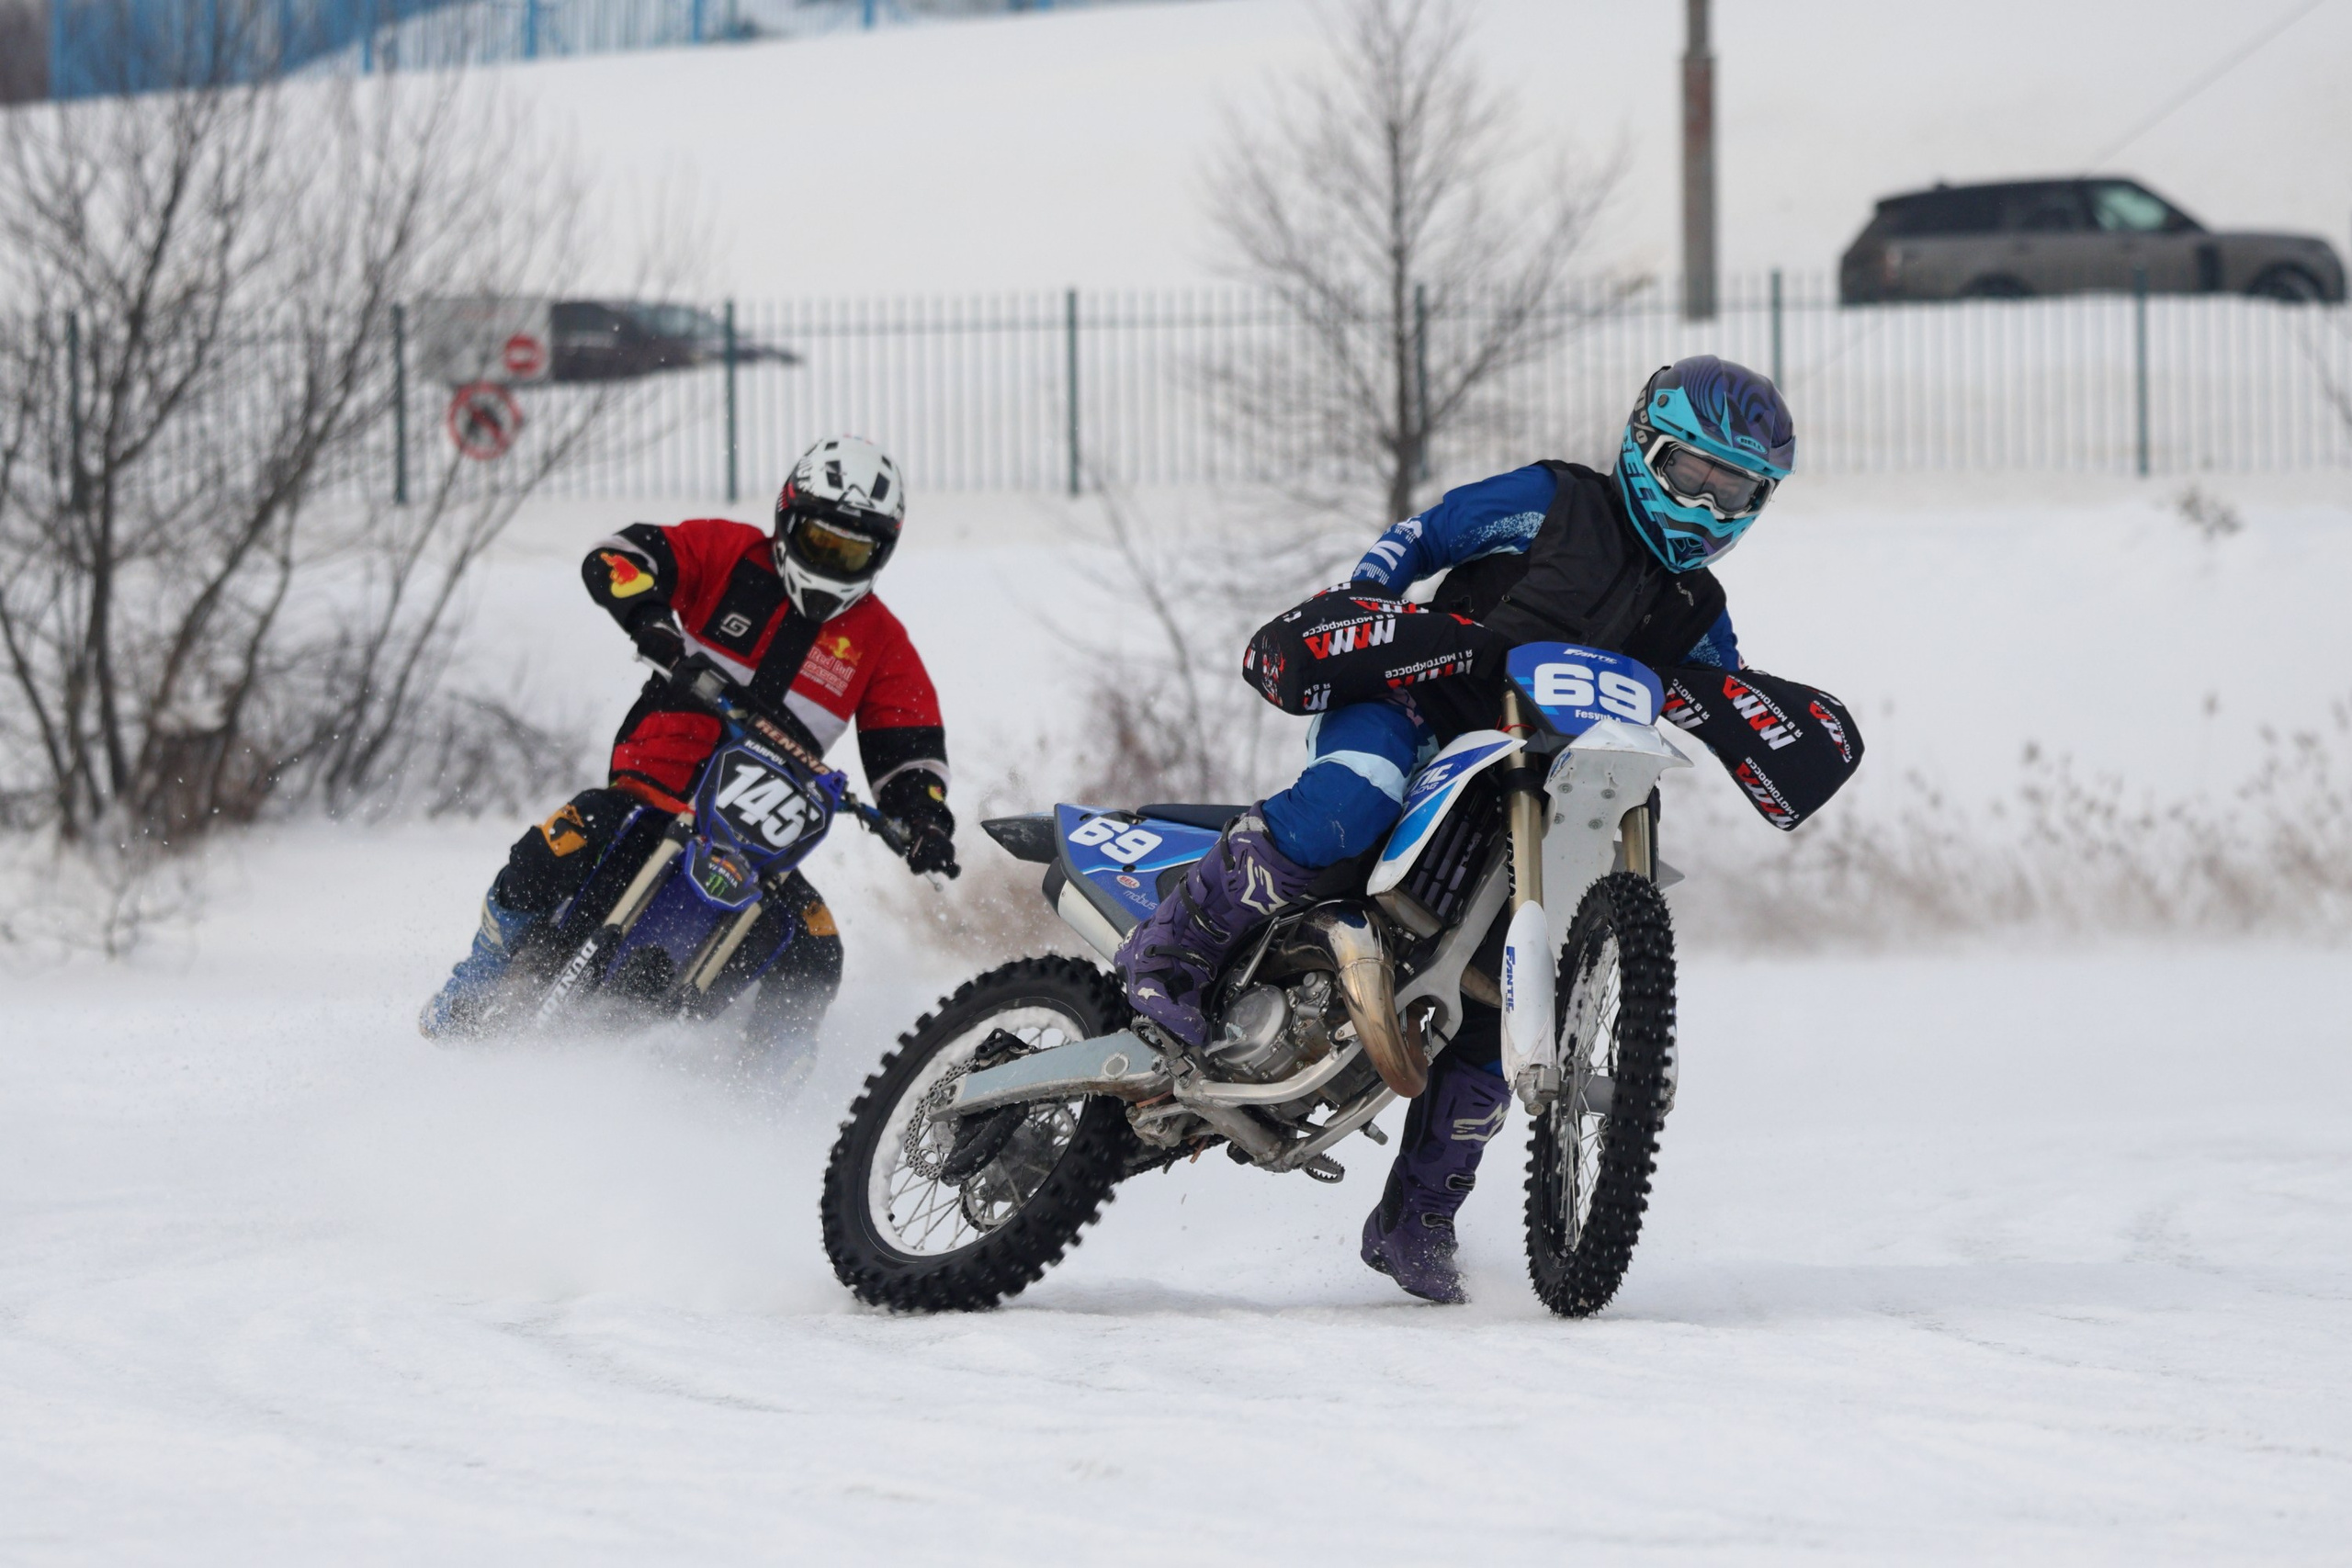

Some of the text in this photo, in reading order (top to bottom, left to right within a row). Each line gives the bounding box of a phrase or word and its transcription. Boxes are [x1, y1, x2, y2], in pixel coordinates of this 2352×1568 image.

[1564, 648, 1619, 664] FANTIC
[1534, 662, 1652, 726] 69
[744, 739, 787, 766] KARPOV
[717, 763, 820, 848] 145
[1068, 816, 1163, 864] 69
[1120, 875, 1137, 887] BELL
[1123, 890, 1158, 910] mobius
[1506, 945, 1516, 1011] FANTIC
